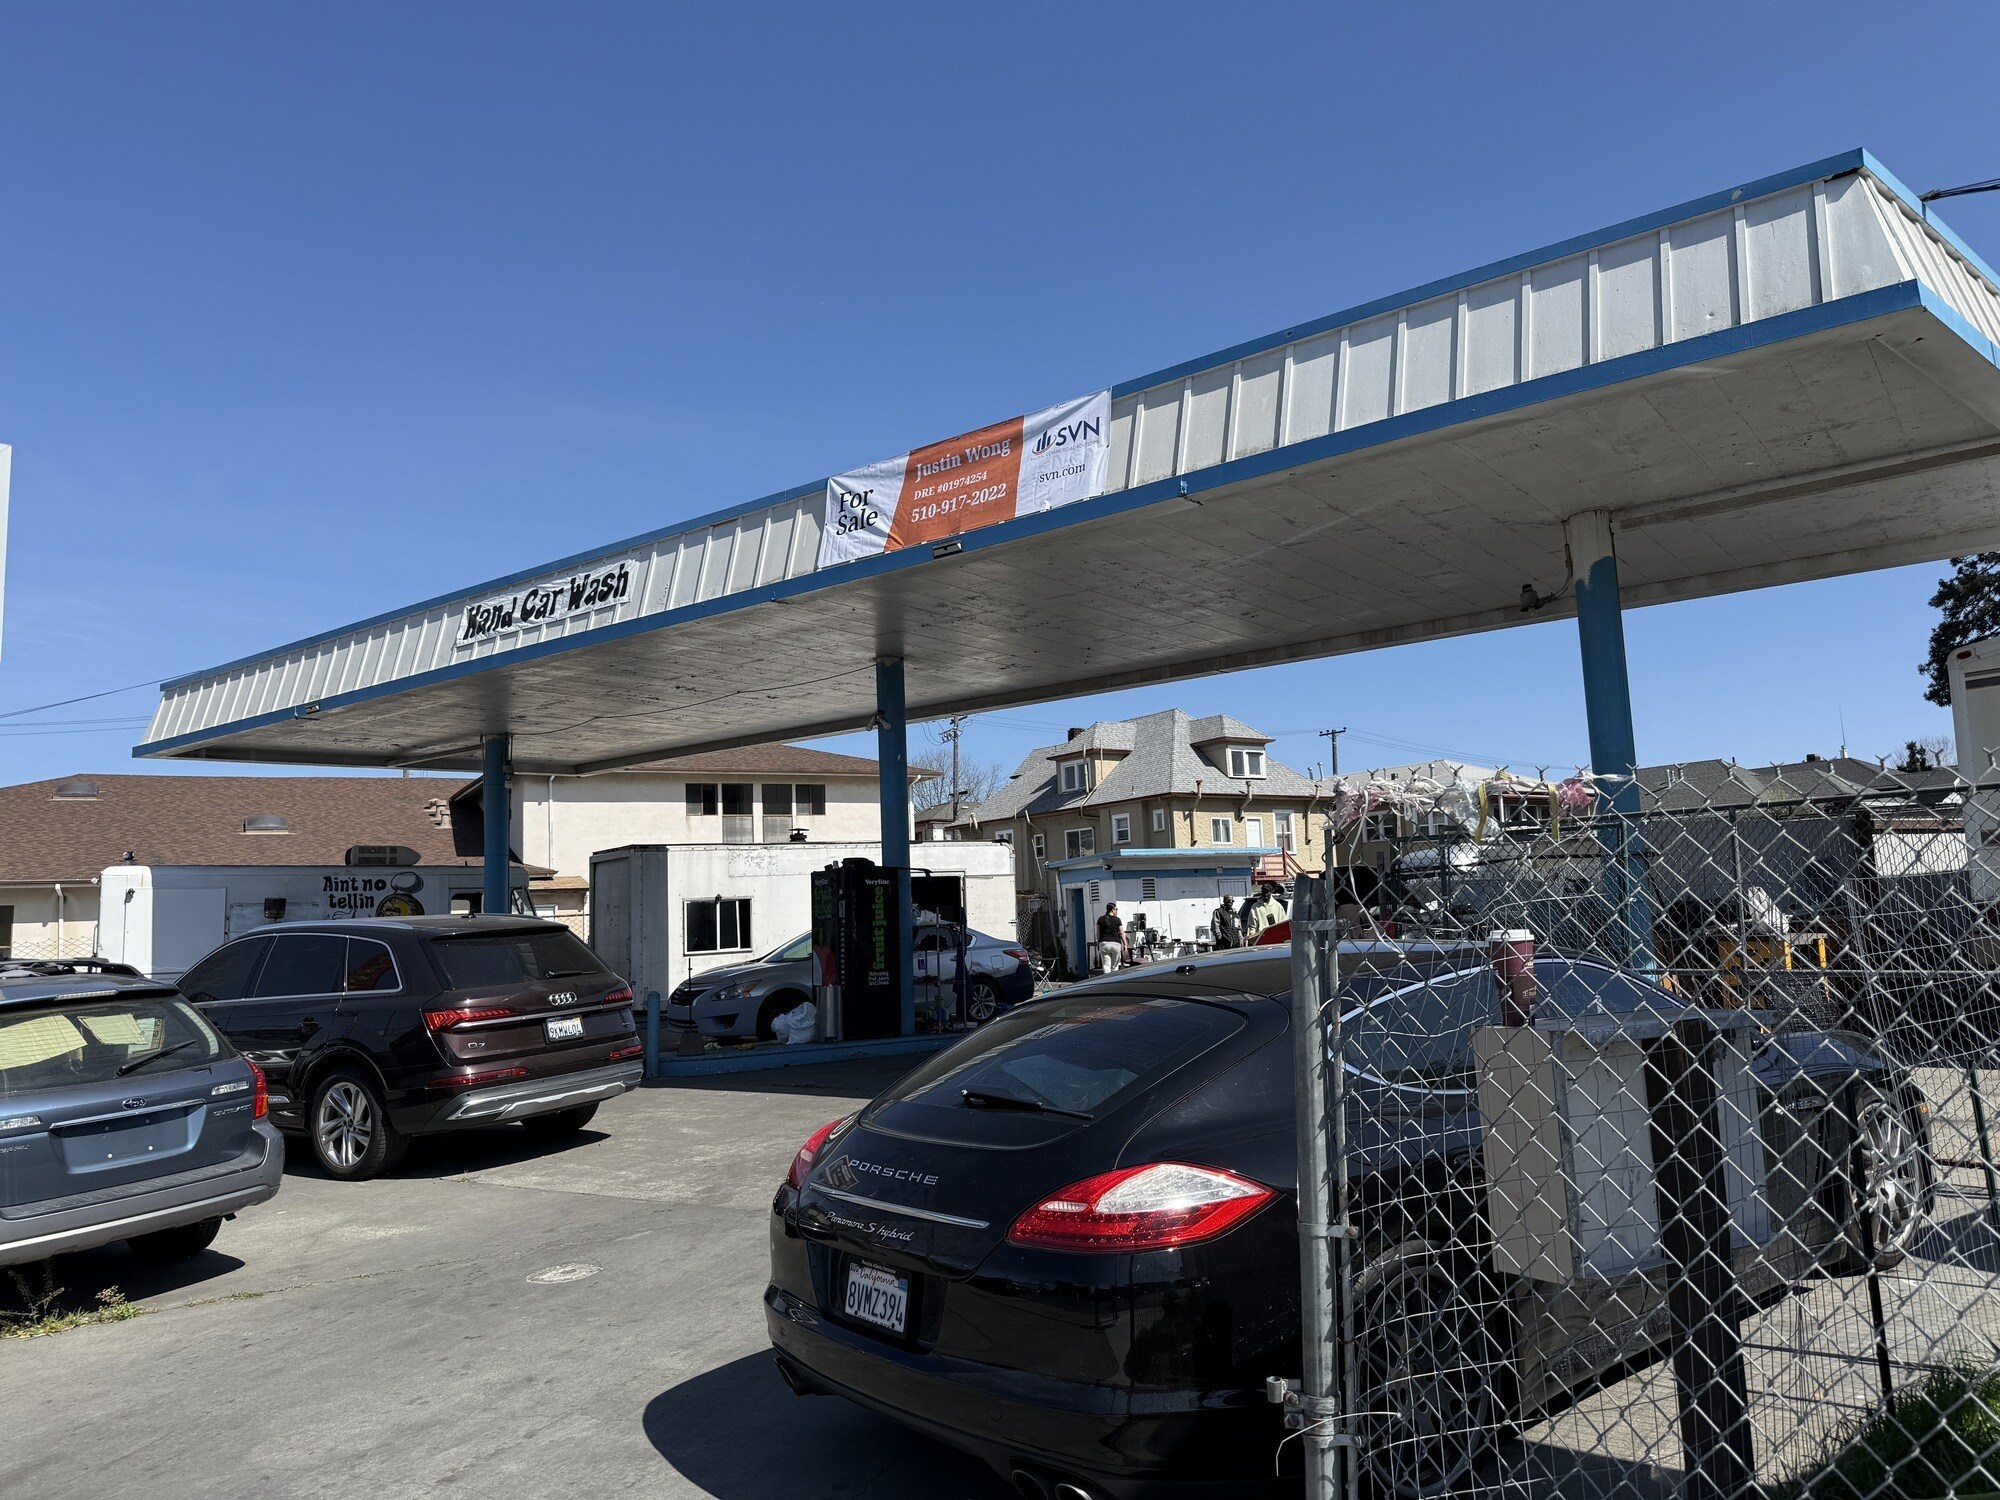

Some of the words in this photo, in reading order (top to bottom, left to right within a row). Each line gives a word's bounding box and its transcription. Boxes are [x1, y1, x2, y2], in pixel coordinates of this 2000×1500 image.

[1055, 416, 1100, 446] SVN
[915, 453, 961, 483] Justin
[965, 438, 1011, 457] Wong
[1039, 463, 1086, 483] svn.com
[913, 486, 935, 500] DRE
[937, 470, 987, 493] #01974254
[838, 488, 874, 513] For
[911, 482, 1007, 522] 510-917-2022
[836, 508, 878, 535] Sale
[463, 597, 517, 640] Hand
[520, 587, 564, 623] Car
[567, 563, 629, 611] Wash
[322, 875, 359, 892] Ain't
[362, 878, 387, 892] no
[328, 893, 375, 909] tellin
[872, 886, 886, 926] juice
[873, 927, 885, 970] fruit
[848, 1159, 939, 1186] PORSCHE
[825, 1211, 864, 1231] Panamera
[863, 1222, 877, 1233] S
[876, 1226, 915, 1241] hybrid
[860, 1266, 899, 1289] California
[848, 1281, 903, 1326] 8VMZ394
